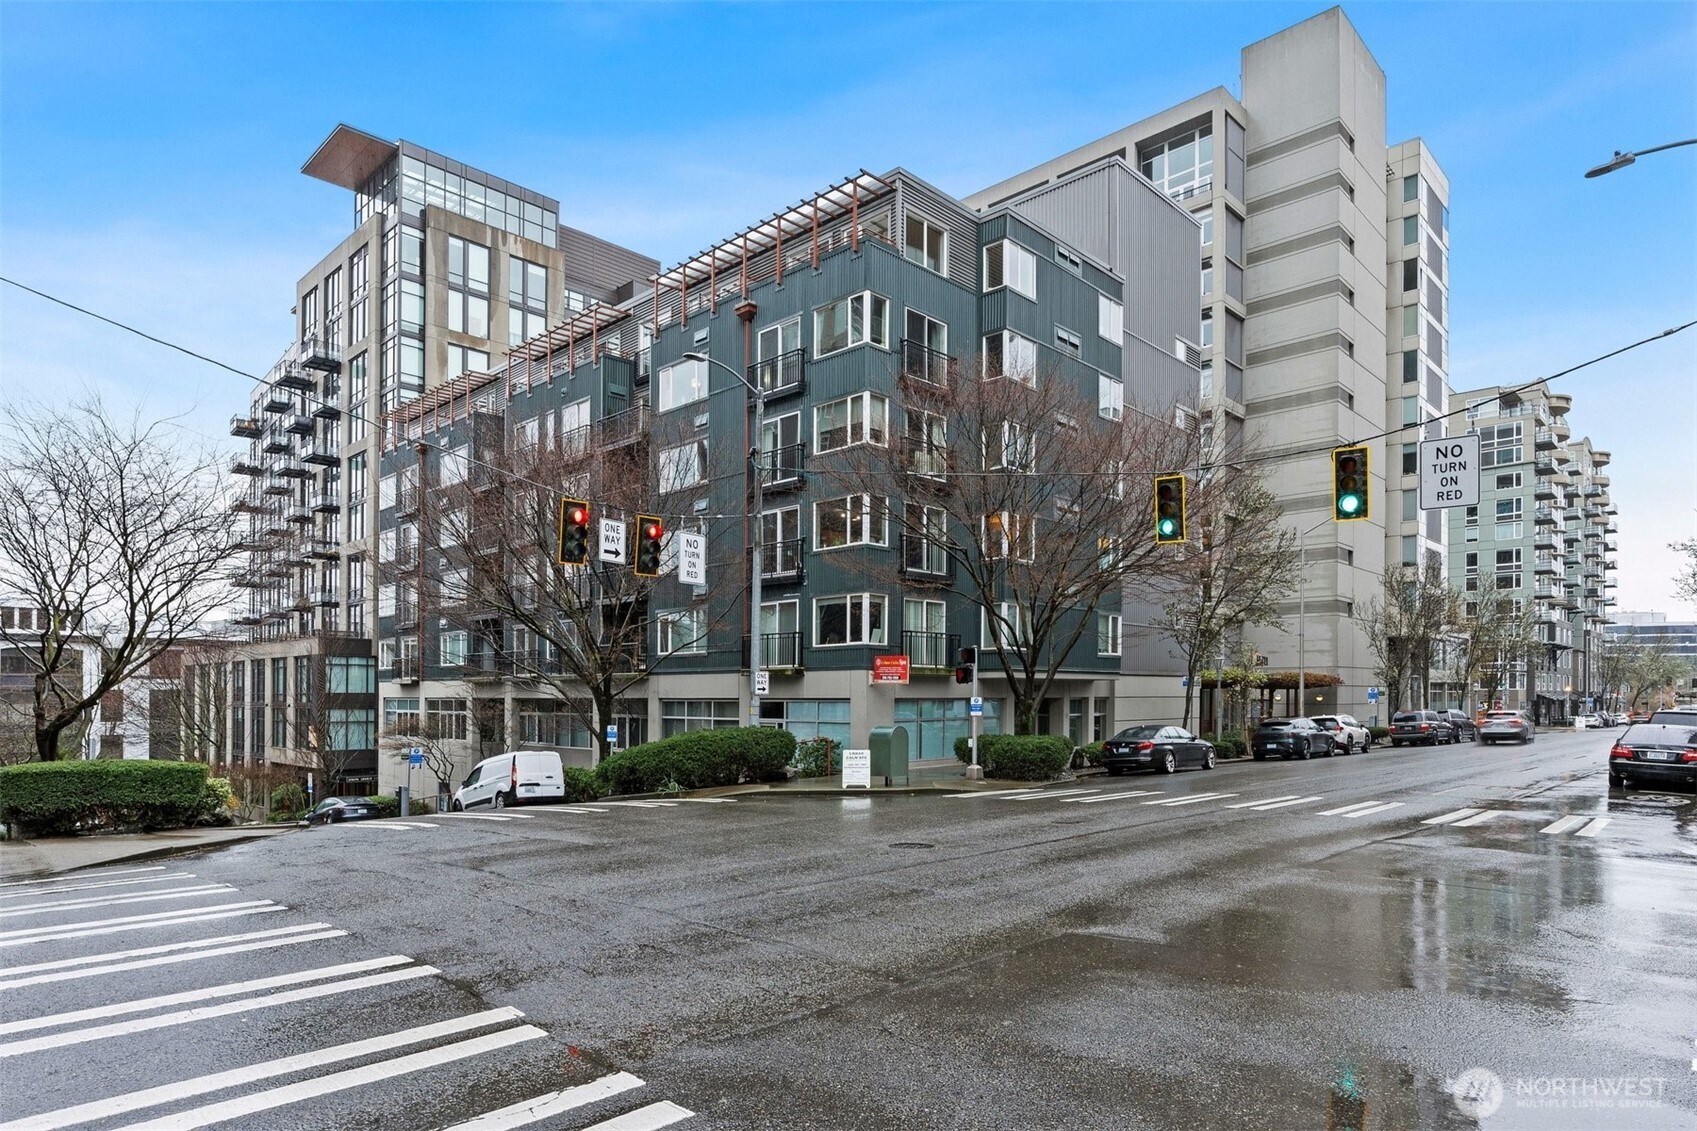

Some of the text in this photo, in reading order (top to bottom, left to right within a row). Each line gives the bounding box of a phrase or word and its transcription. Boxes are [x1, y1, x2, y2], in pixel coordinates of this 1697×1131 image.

[1436, 444, 1463, 460] NO
[1432, 460, 1467, 474] TURN
[1440, 475, 1458, 488] ON
[1436, 489, 1463, 502] RED
[604, 522, 621, 535] ONE
[604, 534, 621, 546] WAY
[686, 538, 699, 549] NO
[684, 550, 701, 560] TURN
[687, 560, 697, 569] ON
[686, 570, 698, 579] RED
